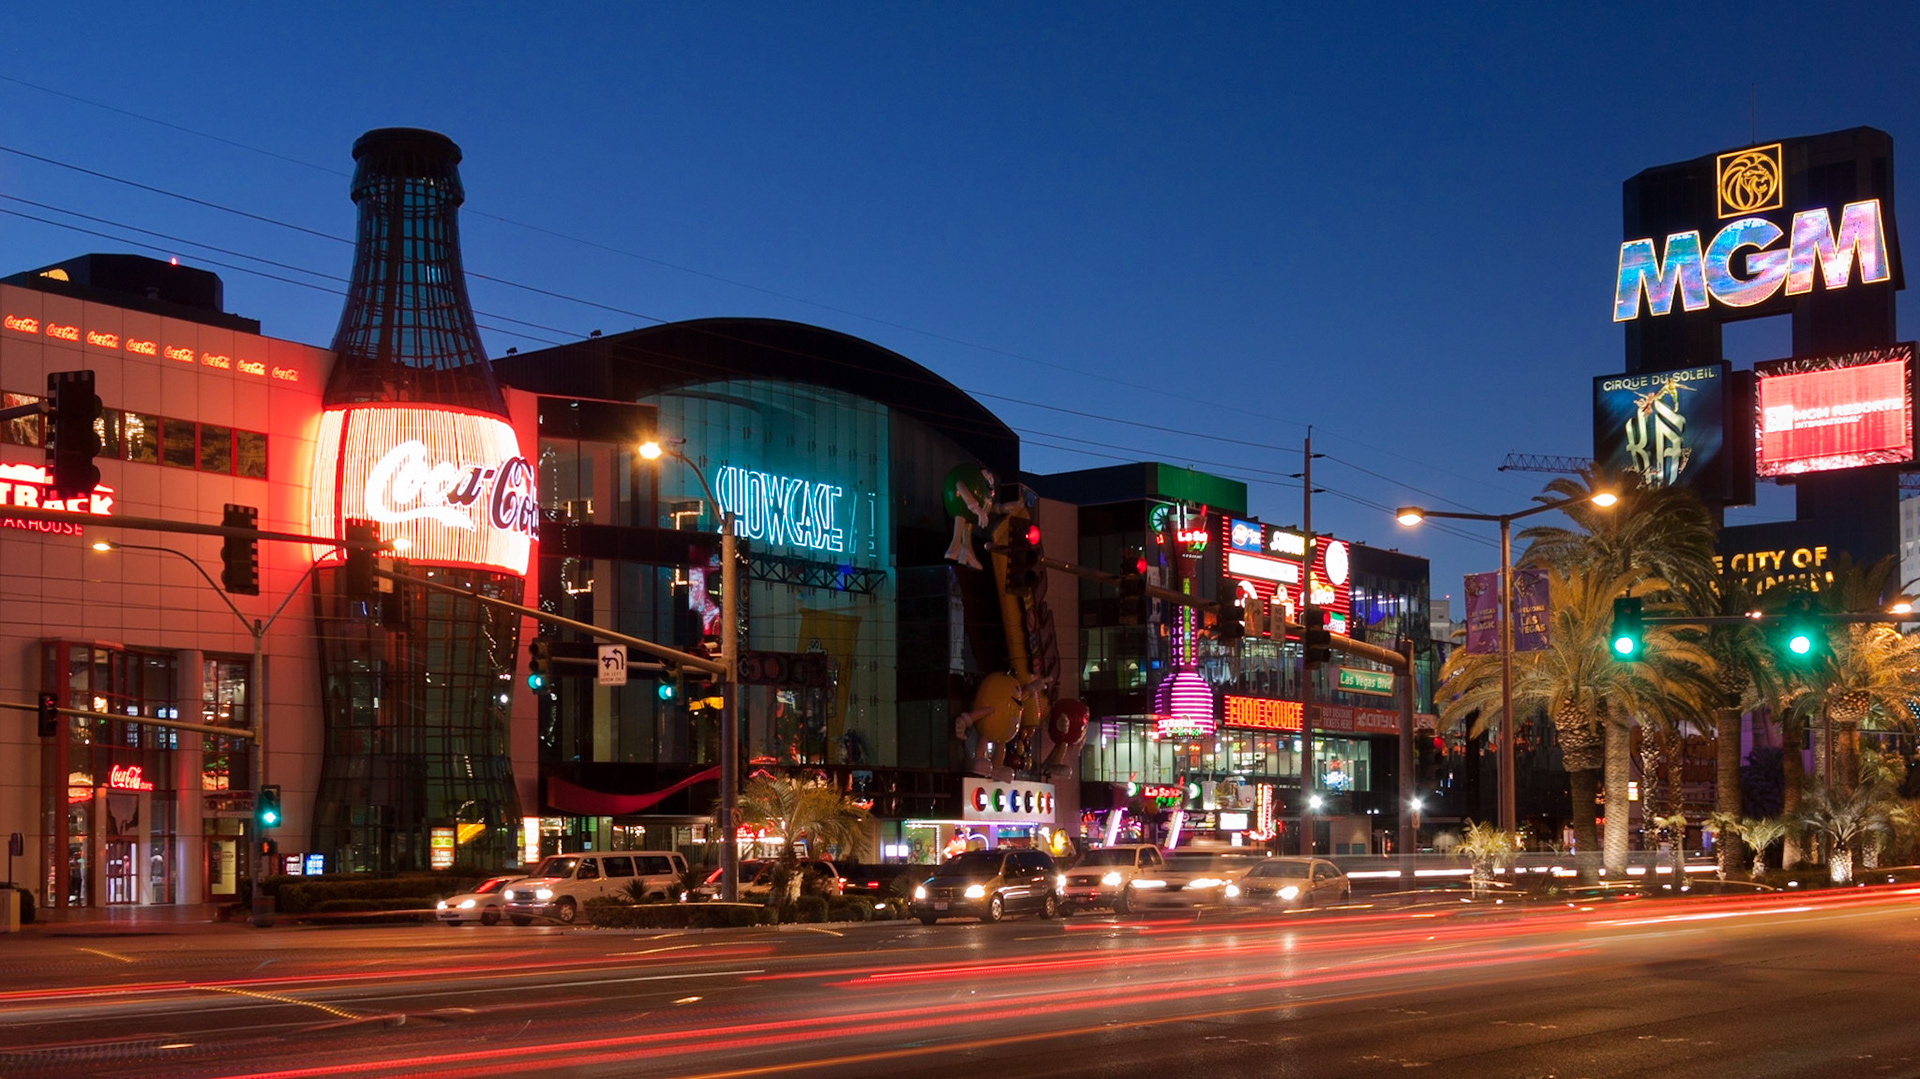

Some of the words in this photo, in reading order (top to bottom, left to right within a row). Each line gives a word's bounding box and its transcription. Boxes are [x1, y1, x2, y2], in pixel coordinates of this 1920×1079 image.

[1613, 198, 1890, 322] MGM
[1672, 368, 1715, 382] SOLEIL
[1794, 406, 1829, 421] MGM
[1832, 397, 1903, 417] RESORTS
[716, 465, 843, 552] SHOWCASE
[1731, 549, 1785, 573] CITY
[1792, 545, 1828, 569] OF
[1340, 673, 1354, 685] Las
[1355, 674, 1375, 690] Vegas
[1376, 677, 1393, 689] Blvd
[1230, 696, 1260, 726] FOOD
[1264, 698, 1303, 730] COURT
